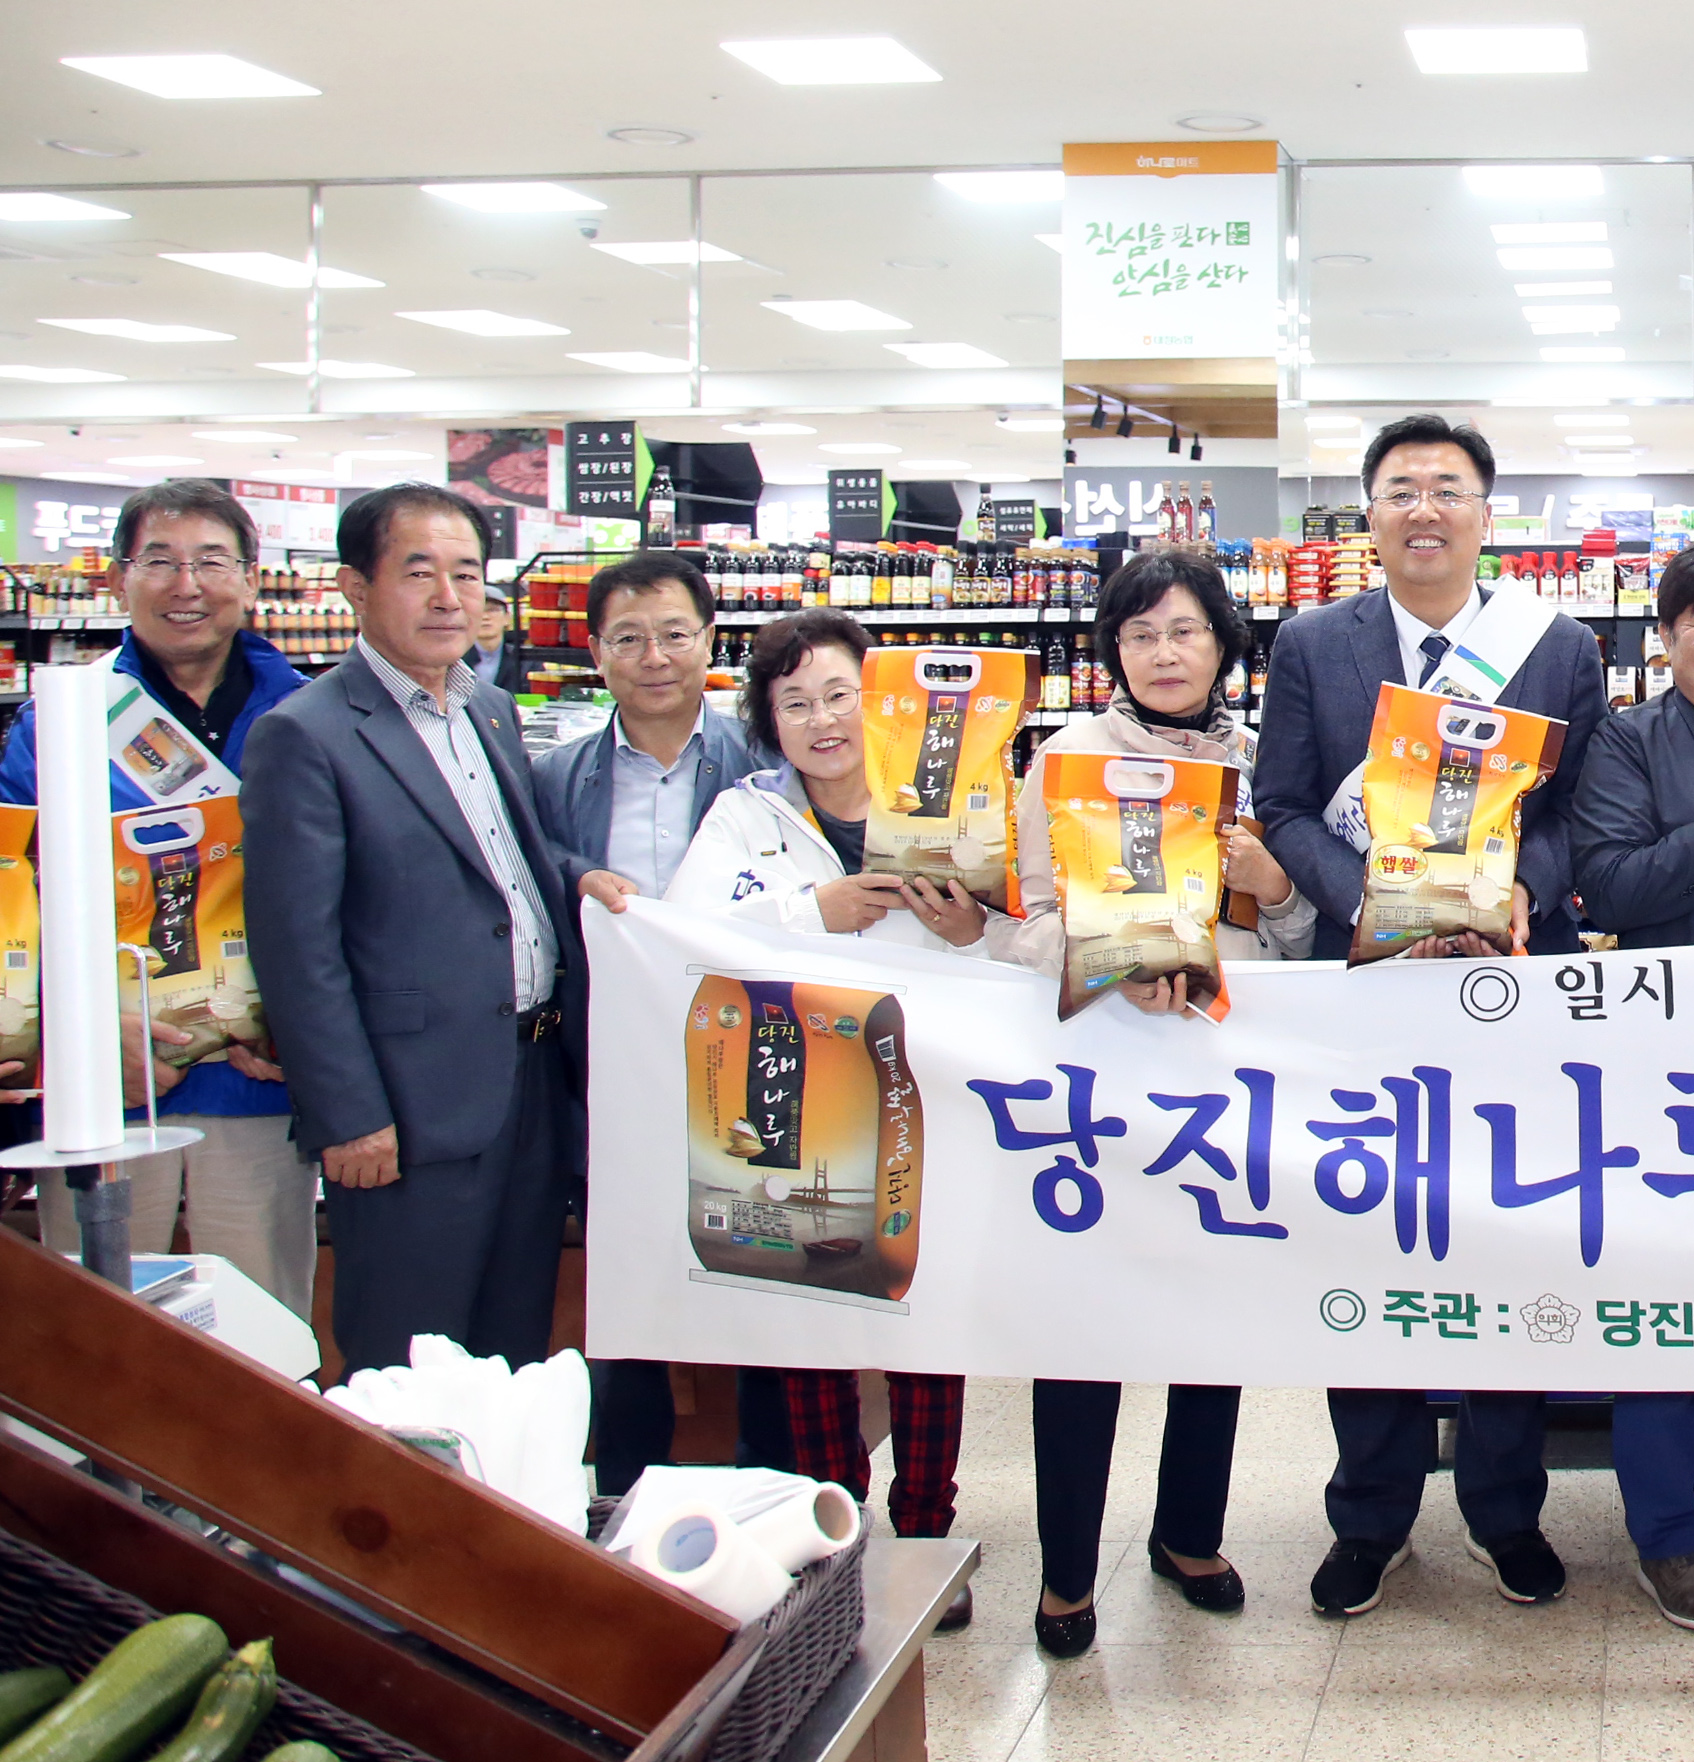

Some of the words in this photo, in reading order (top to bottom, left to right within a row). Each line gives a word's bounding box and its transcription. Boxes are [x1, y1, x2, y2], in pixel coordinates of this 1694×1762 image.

[1085, 221, 1166, 260] 진심을
[1171, 221, 1222, 249] 판다
[1112, 259, 1191, 298] 안심을
[1197, 262, 1250, 289] 산다
[577, 432, 632, 445] 고추장
[929, 714, 959, 728] 당진
[922, 729, 955, 800] 해나루
[1440, 767, 1473, 785] 당진
[1123, 812, 1157, 822] 당진
[1438, 779, 1470, 838] 해나루
[1126, 821, 1156, 878] 해나루
[1381, 855, 1418, 875] 햅쌀
[157, 871, 195, 889] 당진
[161, 893, 193, 955] 해나루
[1554, 957, 1675, 1021] 일시
[757, 1024, 800, 1043] 당진
[757, 1045, 799, 1147] 해나루
[704, 1200, 715, 1210] 20
[716, 1202, 727, 1213] kg
[1384, 1292, 1480, 1339] 주관
